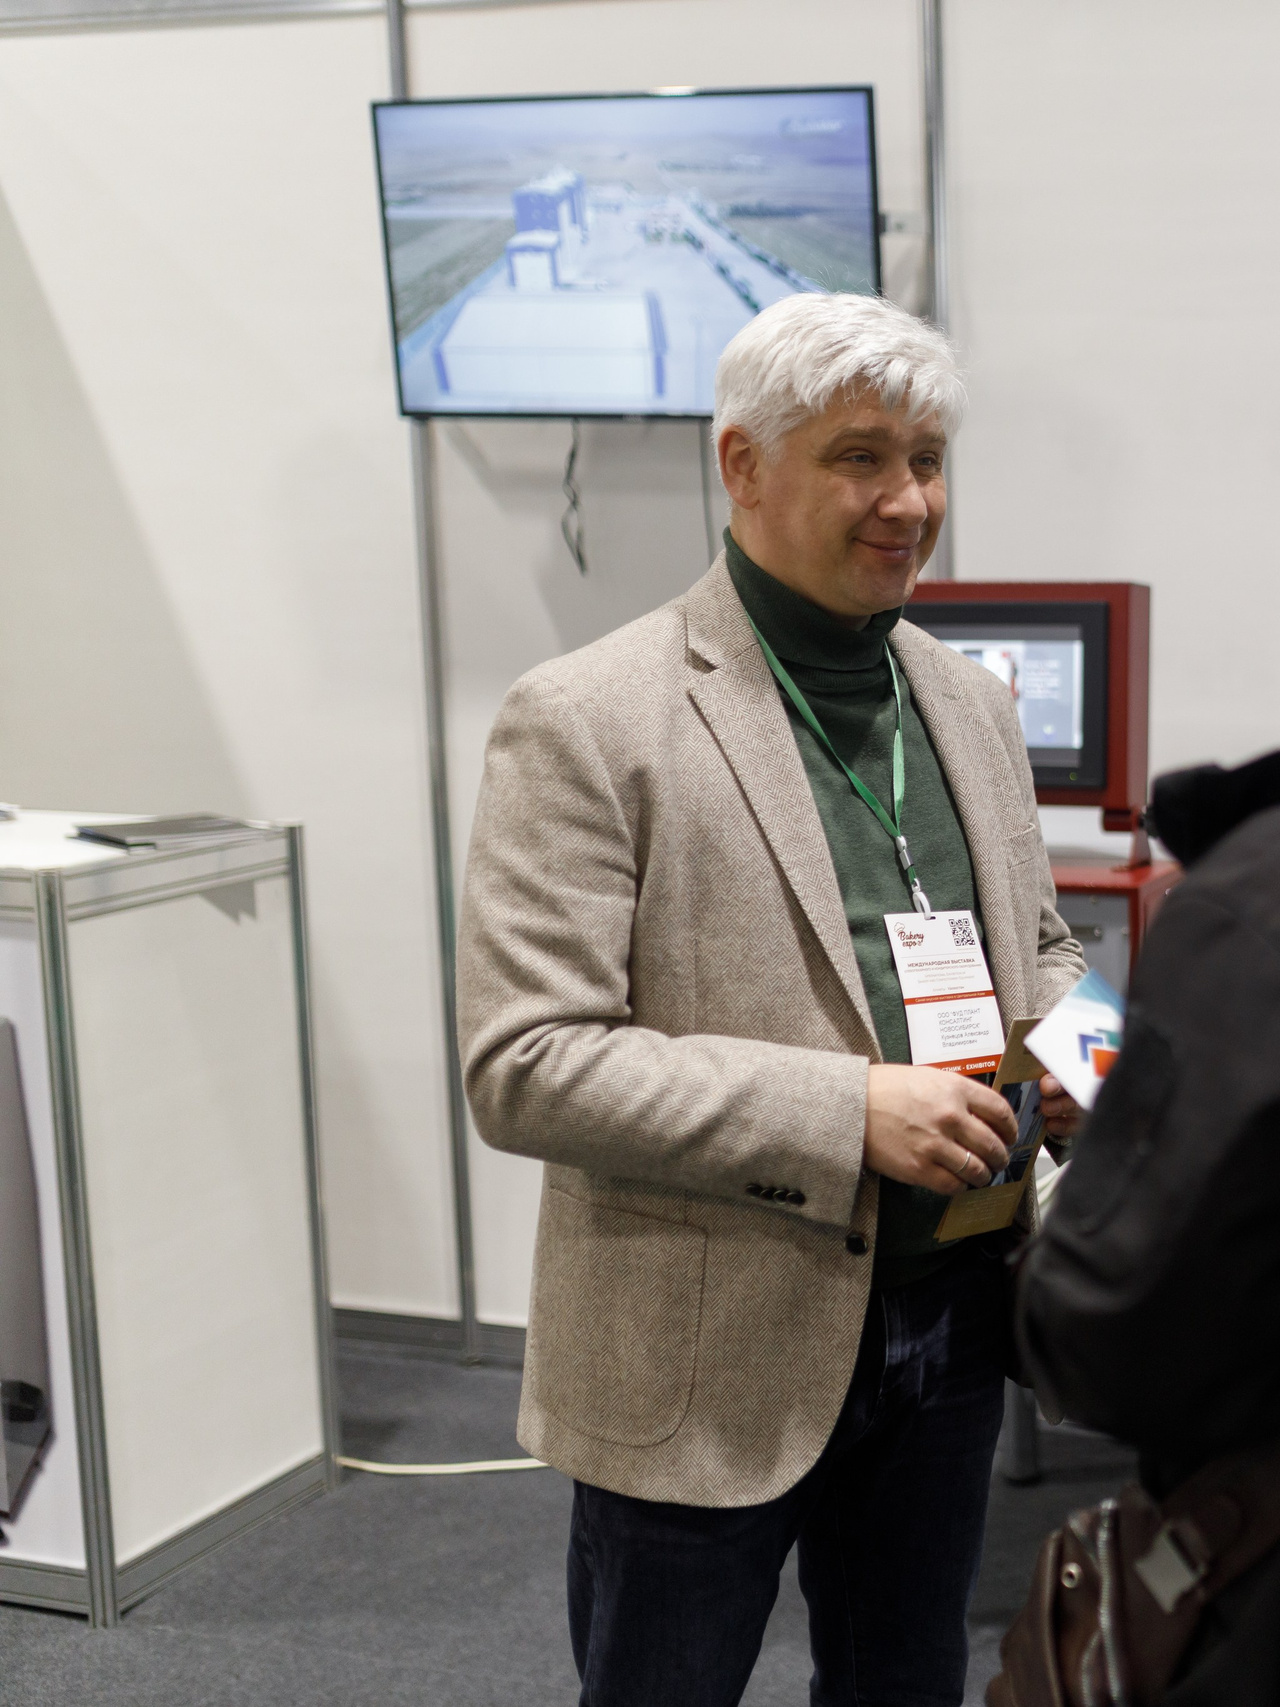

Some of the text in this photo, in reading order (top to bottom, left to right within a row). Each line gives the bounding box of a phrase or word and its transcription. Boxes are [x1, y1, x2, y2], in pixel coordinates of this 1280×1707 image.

[898, 931, 924, 942] Bakery
[902, 941, 917, 949] expo
[939, 1017, 972, 1025] КОНСАЛТИНГ
[965, 1030, 989, 1038] Александр
[942, 1039, 977, 1047] Владимирович
[966, 1061, 995, 1070] EXHIBITOR
